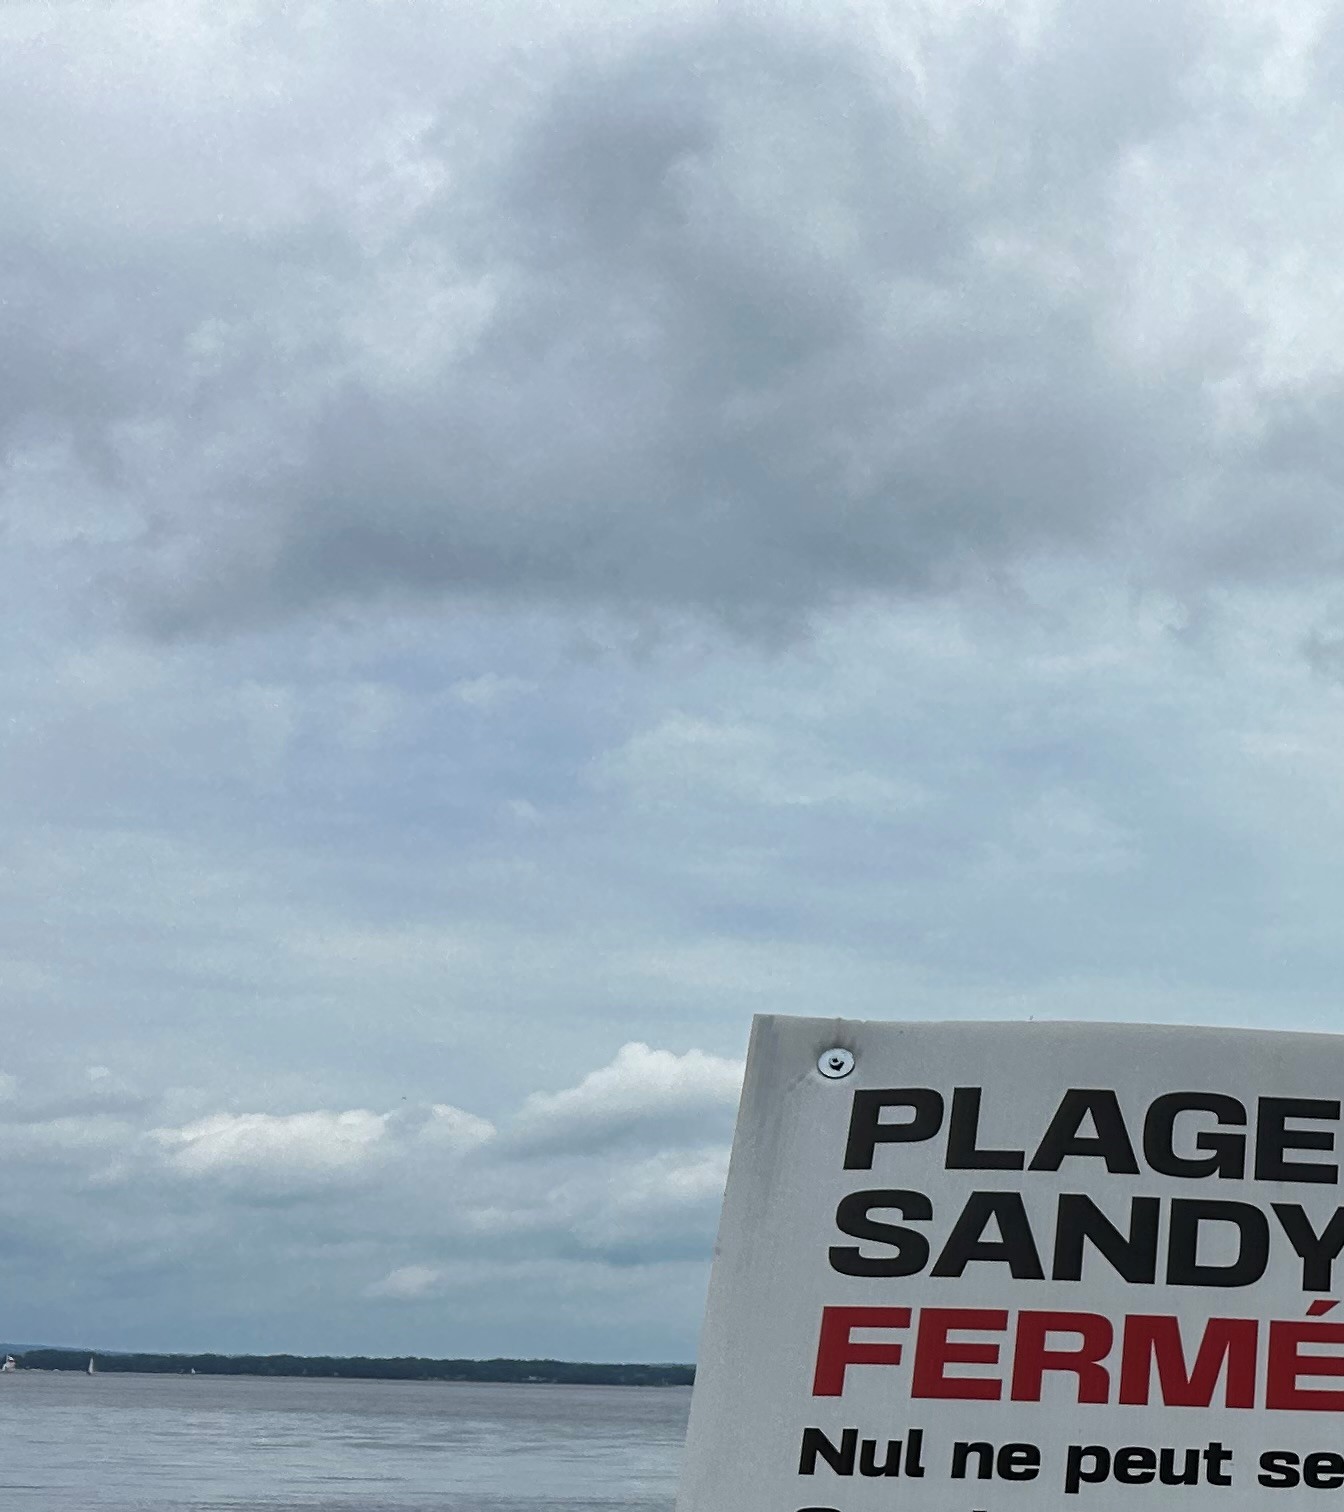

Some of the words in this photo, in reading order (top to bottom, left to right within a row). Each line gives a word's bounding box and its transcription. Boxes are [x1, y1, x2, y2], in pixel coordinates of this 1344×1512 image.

[843, 1087, 1340, 1184] PLAGE
[799, 1428, 924, 1477] Nul
[951, 1442, 1040, 1481] ne
[1065, 1443, 1232, 1494] peut
[1258, 1451, 1344, 1489] se
